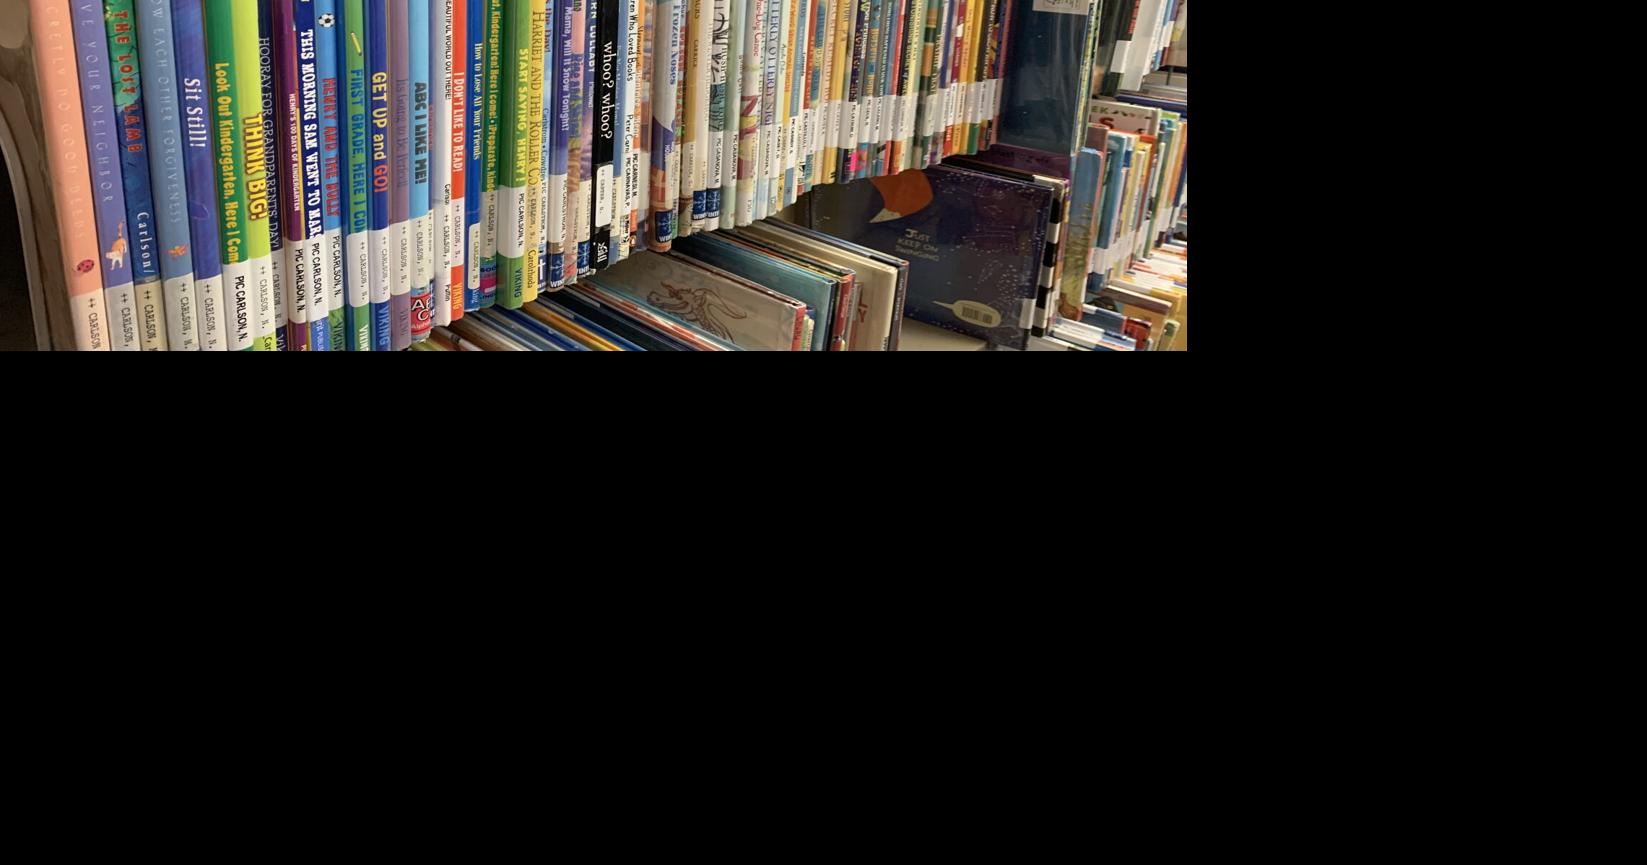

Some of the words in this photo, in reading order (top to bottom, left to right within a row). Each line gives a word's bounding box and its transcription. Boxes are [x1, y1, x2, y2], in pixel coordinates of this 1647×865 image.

[113, 10, 131, 43] THE
[562, 6, 572, 38] Mama,
[628, 14, 638, 31] Who
[671, 5, 681, 48] Frozen
[153, 28, 168, 67] EACH
[300, 29, 314, 59] THIS
[474, 43, 483, 60] How
[489, 11, 500, 68] Kindergarten!
[531, 12, 545, 63] HARRIET
[562, 40, 572, 56] Will
[627, 33, 637, 56] Loved
[117, 54, 136, 94] LOST
[215, 63, 231, 92] Look
[259, 37, 271, 89] HOORAY
[474, 63, 482, 71] to
[519, 48, 529, 83] START
[602, 41, 617, 88] whoo?
[626, 58, 636, 82] Books
[670, 51, 679, 86] Noses
[184, 78, 202, 100] Sit
[302, 63, 317, 119] MORNING
[350, 69, 364, 106] FIRST
[372, 72, 387, 102] GET
[453, 79, 464, 105] DON'T
[474, 74, 483, 93] Lose
[489, 69, 499, 89] Here
[530, 66, 541, 91] AND
[562, 68, 571, 92] Snow
[158, 77, 173, 121] OTHER
[217, 96, 233, 116] Out
[262, 92, 273, 116] FOR
[289, 93, 297, 121] HENRY'S
[322, 78, 337, 119] HENRY
[394, 95, 408, 124] Going
[414, 82, 427, 111] ABC
[473, 96, 482, 107] All
[488, 95, 498, 119] come!
[530, 95, 541, 117] THE
[82, 42, 100, 91] YOUR
[91, 105, 113, 203] NEIGHBOR
[372, 107, 387, 128] UP
[453, 109, 465, 129] LIKE
[473, 110, 482, 127] Your
[516, 87, 528, 136] SAVING,
[559, 95, 570, 131] Tonight?
[600, 93, 615, 139] whoo?
[625, 115, 633, 132] Peter
[124, 104, 143, 153] LAMB
[186, 107, 207, 147] Still!
[304, 124, 318, 149] SAM
[324, 126, 338, 151] AND
[396, 126, 407, 135] to
[414, 125, 427, 155] LIKE
[453, 131, 464, 142] TO
[243, 113, 266, 176] THINK
[373, 134, 386, 161] and
[396, 138, 408, 151] Be
[473, 129, 482, 160] Friends
[516, 138, 527, 173] HENRY
[529, 121, 541, 165] ROLLER
[291, 154, 298, 162] OF
[305, 152, 320, 186] WENT
[325, 156, 340, 179] THE
[414, 159, 427, 184] ME!
[453, 147, 464, 172] READ!
[163, 130, 181, 223] FORGIVENESS
[292, 164, 300, 211] KINDERGARTEN
[352, 164, 366, 195] HERE
[373, 164, 389, 192] GO!
[246, 178, 269, 221] BIG!
[307, 188, 321, 206] TO
[325, 183, 340, 217] BULLY
[224, 202, 239, 229] Here
[268, 222, 280, 249] DAY!
[312, 243, 320, 255] PIC
[295, 249, 304, 261] PIC
[234, 276, 245, 289] PIC
[295, 264, 305, 303] CARLSON,
[312, 257, 322, 296] CARLSON,
[333, 252, 342, 288] CARLSON,
[514, 268, 522, 298] VIKING
[453, 282, 463, 309] VIKING
[235, 291, 247, 334] CARLSON,
[378, 304, 389, 346] VIKING
[333, 323, 343, 351] VIKIN
[359, 324, 370, 351] VIKIN
